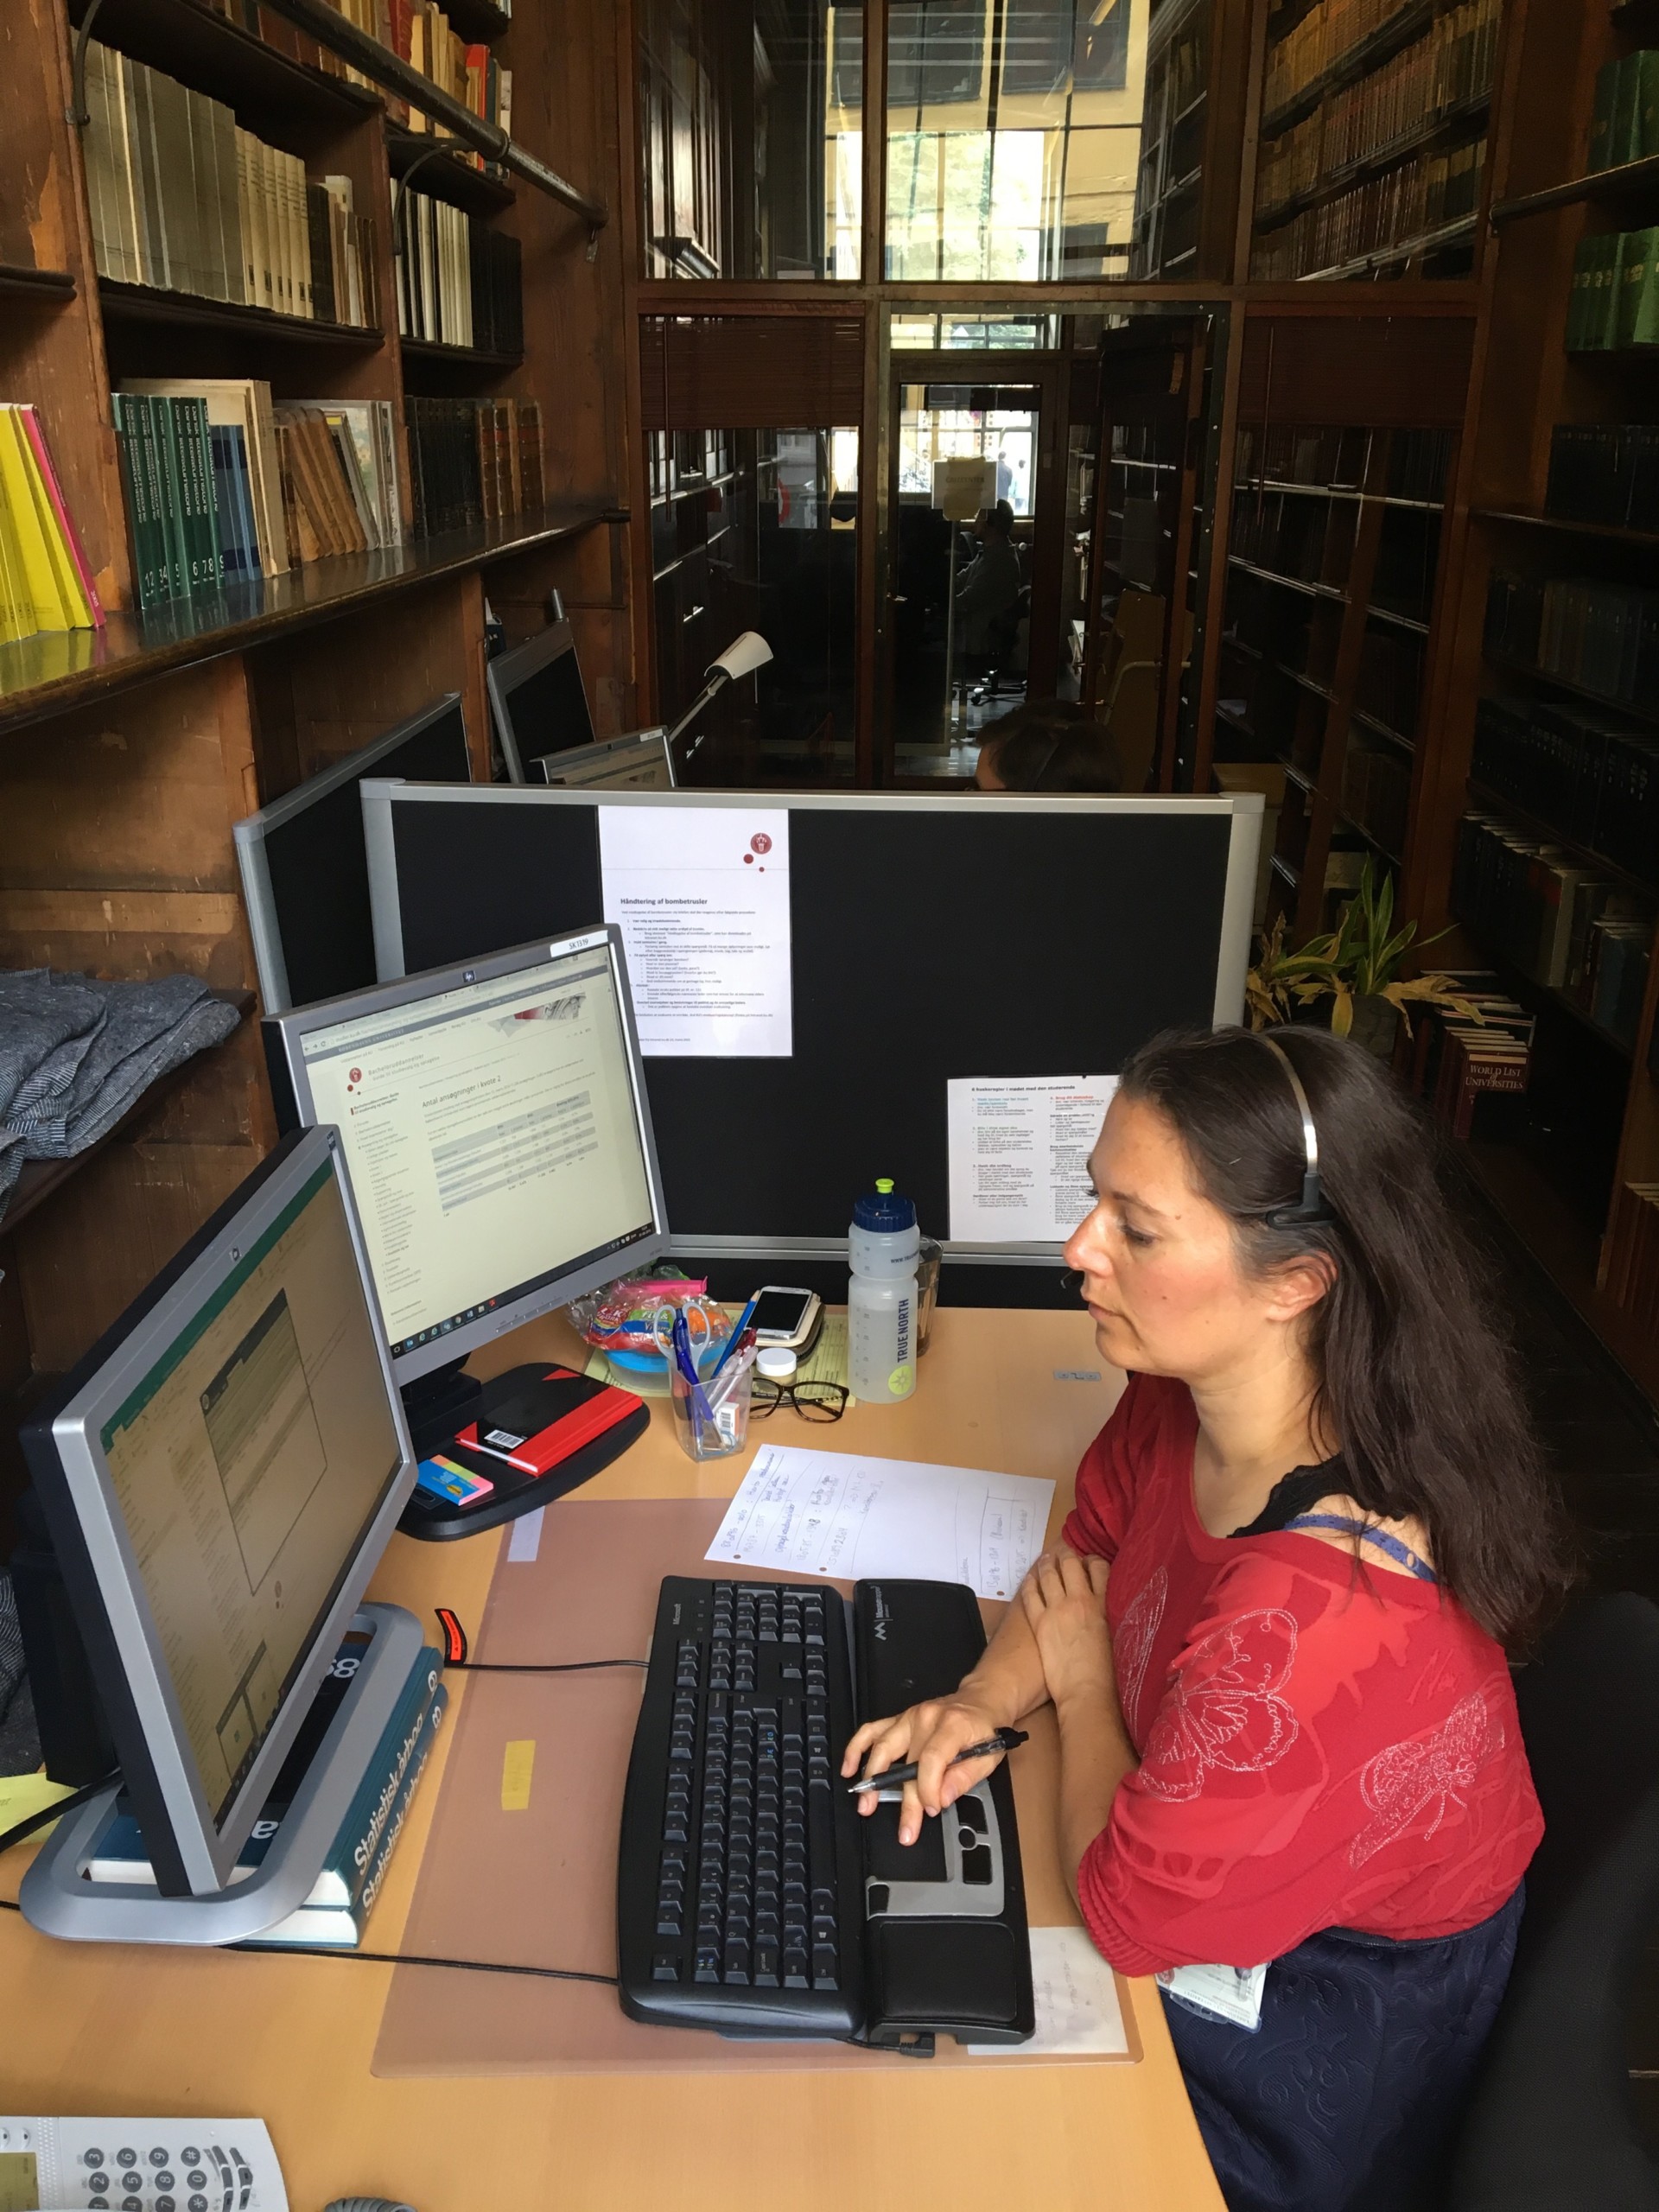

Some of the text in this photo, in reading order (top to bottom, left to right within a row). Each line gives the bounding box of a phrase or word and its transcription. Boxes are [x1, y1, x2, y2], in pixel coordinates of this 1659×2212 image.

[163, 565, 168, 578] 4
[175, 563, 180, 578] 5
[193, 561, 198, 576] 6
[202, 560, 207, 574] 7
[208, 557, 214, 572] 8
[145, 573, 149, 588] 1
[149, 571, 155, 587] 2
[159, 568, 163, 583] 3
[1471, 1065, 1521, 1077] WORLD LIST
[1465, 1077, 1523, 1089] UNIVERSITIES
[422, 1096, 439, 1109] Antal
[439, 1085, 476, 1103] ansøgninger
[480, 1076, 497, 1088] kvote
[897, 1298, 909, 1363] TRUE NORTH
[354, 1772, 399, 1876] Statistisk
